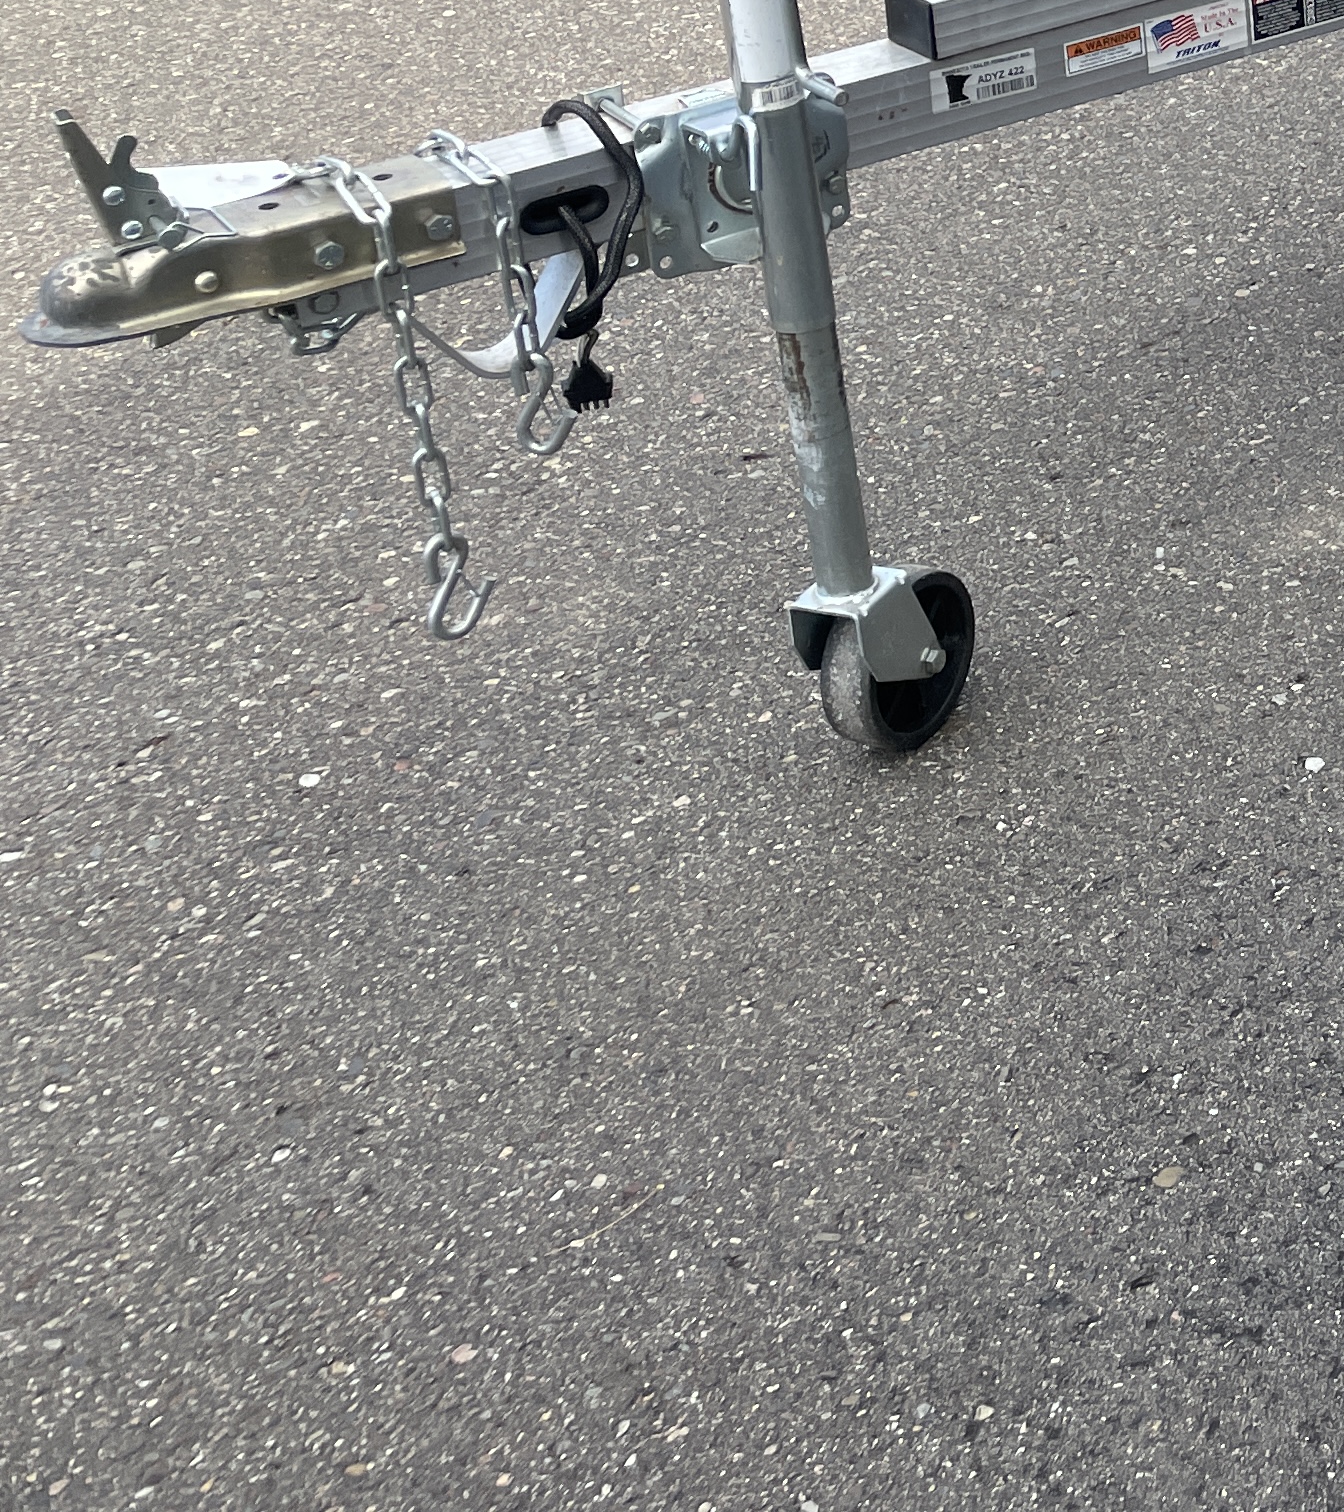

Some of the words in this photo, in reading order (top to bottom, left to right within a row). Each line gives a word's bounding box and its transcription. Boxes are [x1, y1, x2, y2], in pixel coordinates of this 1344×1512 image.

[1085, 30, 1137, 52] WARNING
[1174, 39, 1222, 59] TRITON
[977, 68, 1005, 84] ADYZ
[1007, 65, 1025, 77] 422
